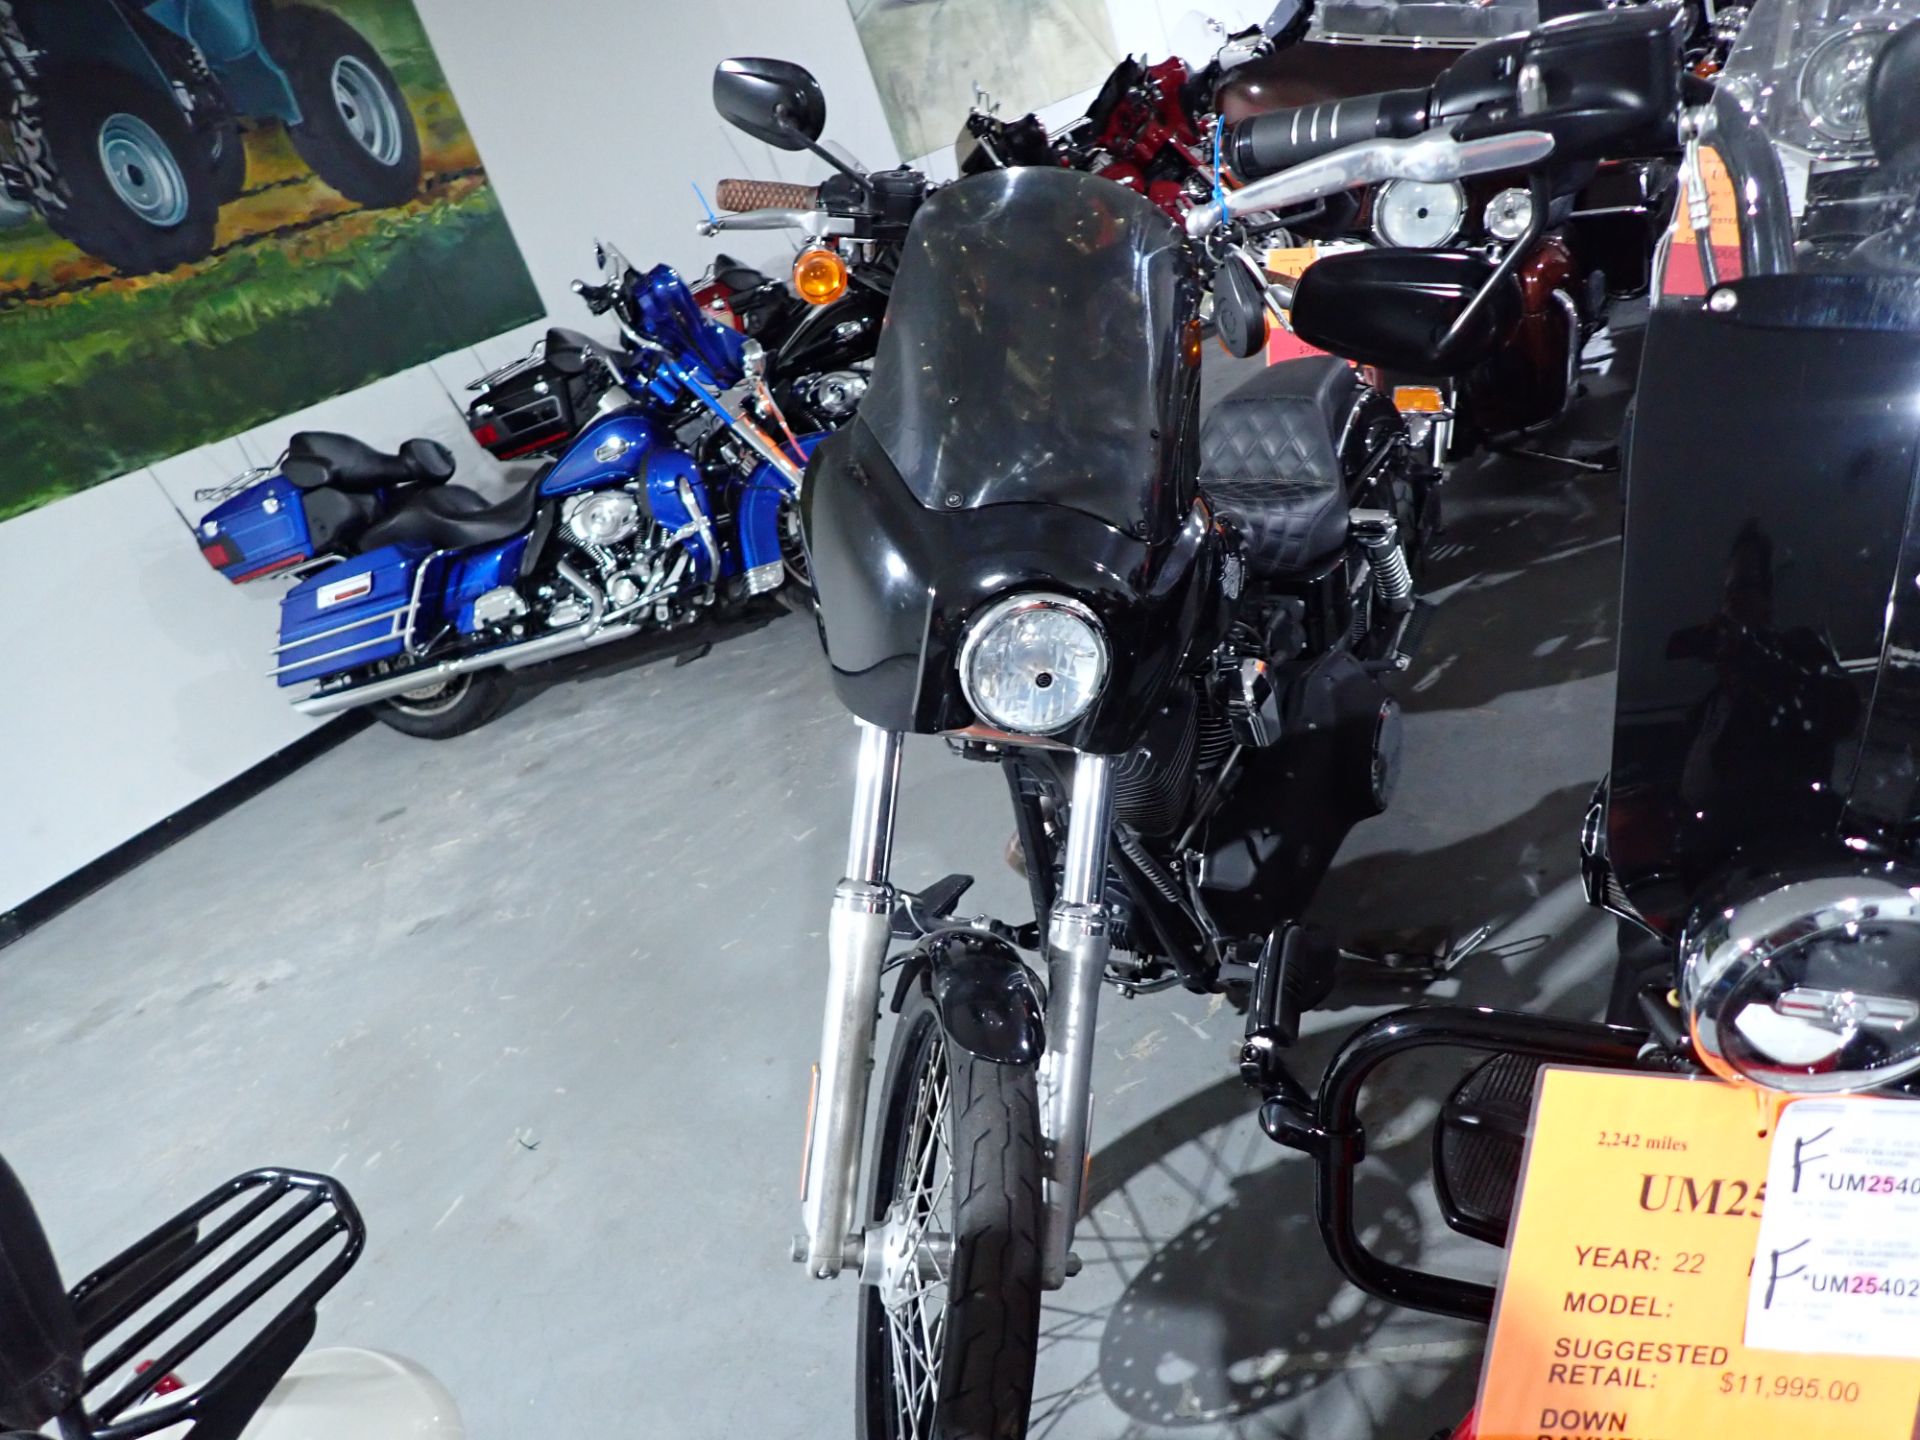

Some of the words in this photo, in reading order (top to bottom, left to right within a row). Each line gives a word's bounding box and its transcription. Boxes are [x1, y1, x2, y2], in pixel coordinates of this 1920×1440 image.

[1597, 1131, 1641, 1148] 2,242
[1645, 1136, 1688, 1152] miles
[1575, 1245, 1660, 1271] YEAR:
[1672, 1252, 1706, 1274] 22
[1563, 1291, 1673, 1318] MODEL:
[1553, 1337, 1729, 1367] SUGGESTED
[1547, 1363, 1657, 1389] RETAIL:
[1719, 1371, 1861, 1403] $11,995.00
[1539, 1408, 1628, 1433] DOWN
